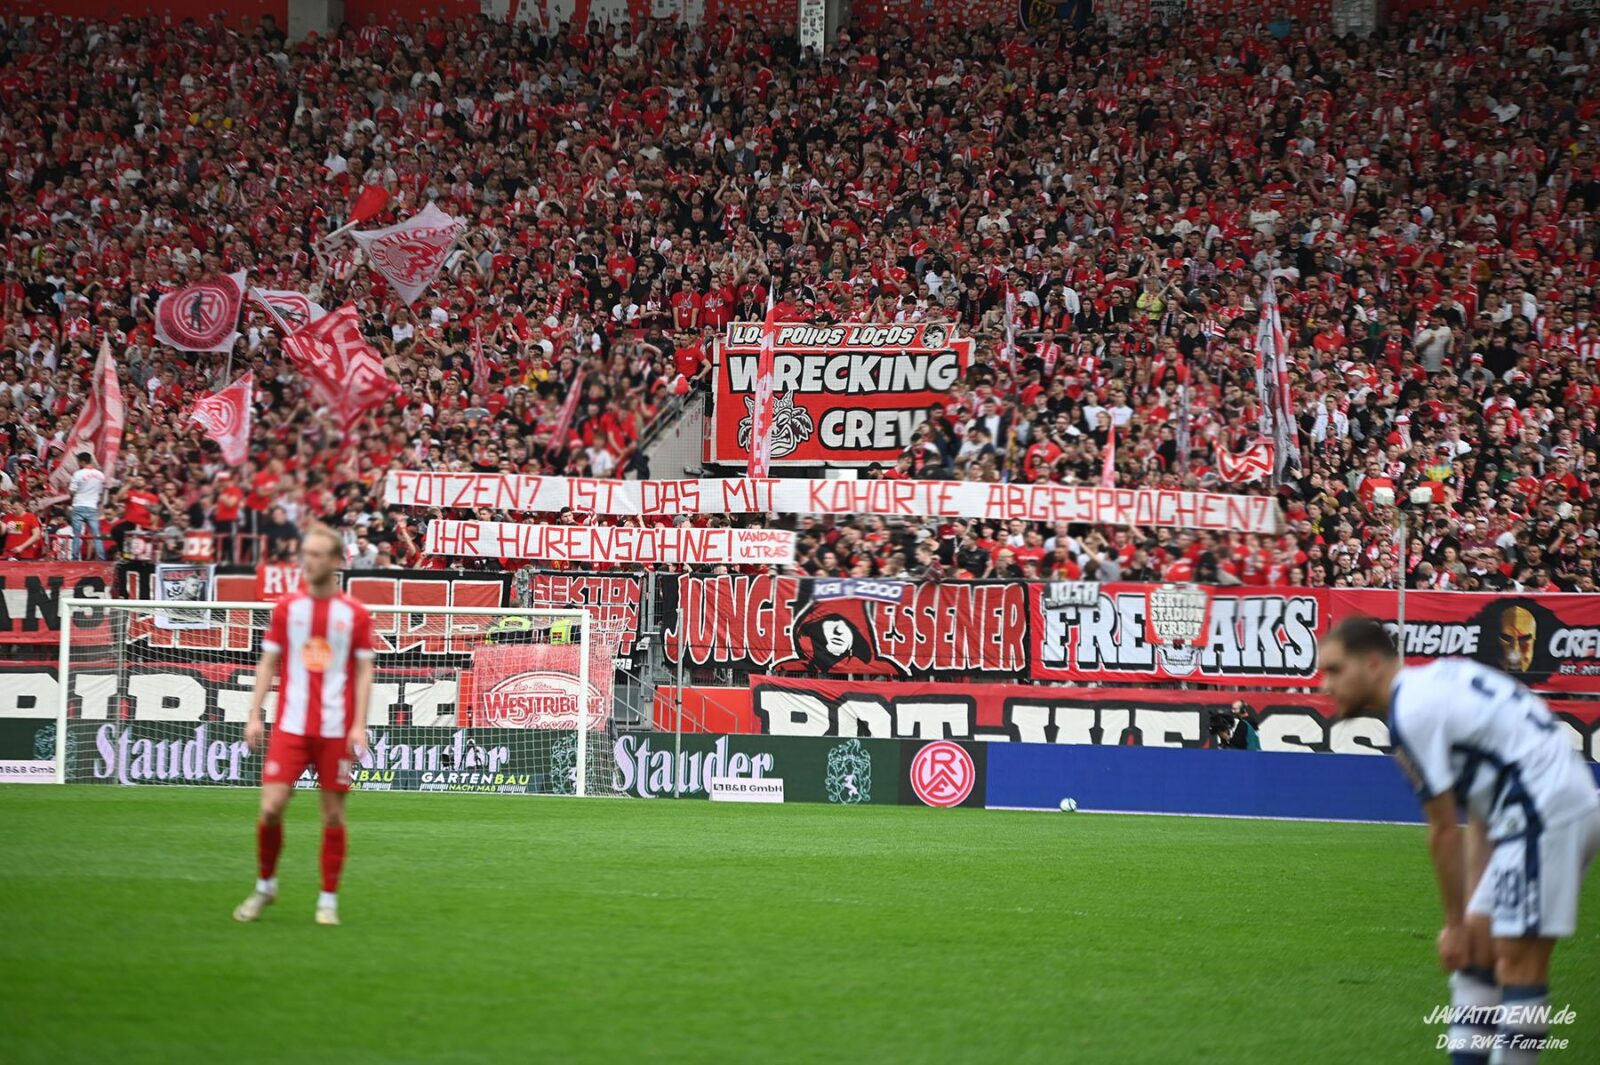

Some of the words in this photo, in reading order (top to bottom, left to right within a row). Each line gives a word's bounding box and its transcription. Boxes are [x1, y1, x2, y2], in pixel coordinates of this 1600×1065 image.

[847, 326, 917, 347] LOCOS
[728, 353, 959, 392] WRECKING
[396, 472, 541, 509] FOTZEN?
[567, 478, 624, 513] IST
[641, 479, 700, 514] DAS
[721, 479, 781, 513] MIT
[809, 479, 962, 516] KOHORTE
[985, 484, 1270, 532] ABGESPROCHEN?
[431, 520, 480, 556] IHR
[740, 545, 789, 558] ULTRAS
[533, 576, 642, 604] SEKTION
[855, 581, 903, 598] 2000
[663, 573, 799, 666] JUNGE
[873, 581, 1027, 672] ESSENER
[1151, 607, 1206, 623] STADION
[1042, 594, 1319, 678] FREAKS
[1153, 621, 1202, 636] VERBOT
[1548, 628, 1600, 658] CRE
[94, 722, 250, 785] Stauder
[29, 765, 56, 774] Gmb
[421, 772, 531, 785] GARTENBAU
[611, 735, 774, 798] Stauder
[448, 783, 474, 791] NACH
[725, 783, 747, 792] B&B
[749, 784, 783, 793] GmbH
